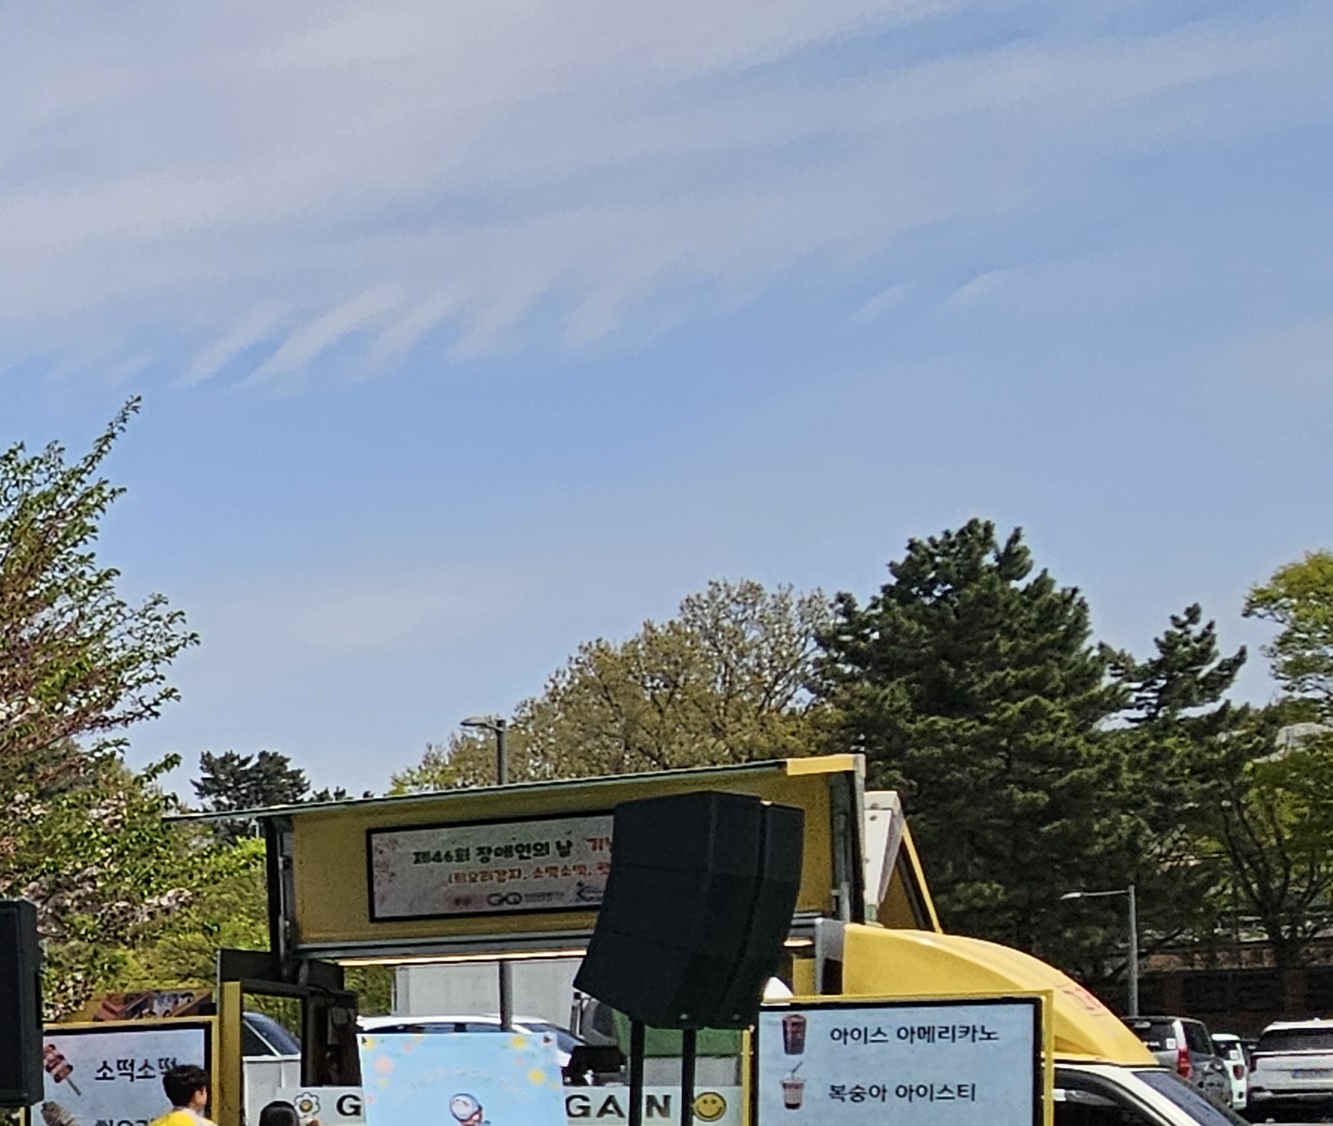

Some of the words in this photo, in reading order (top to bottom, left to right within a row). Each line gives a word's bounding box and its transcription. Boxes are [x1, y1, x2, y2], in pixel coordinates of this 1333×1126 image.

[413, 847, 471, 865] 제46회
[476, 841, 551, 864] 장애인의
[555, 839, 574, 858] 날
[829, 1025, 889, 1045] 아이스
[896, 1024, 1001, 1044] 아메리카노
[828, 1083, 888, 1103] 복숭아
[894, 1083, 977, 1103] 아이스티
